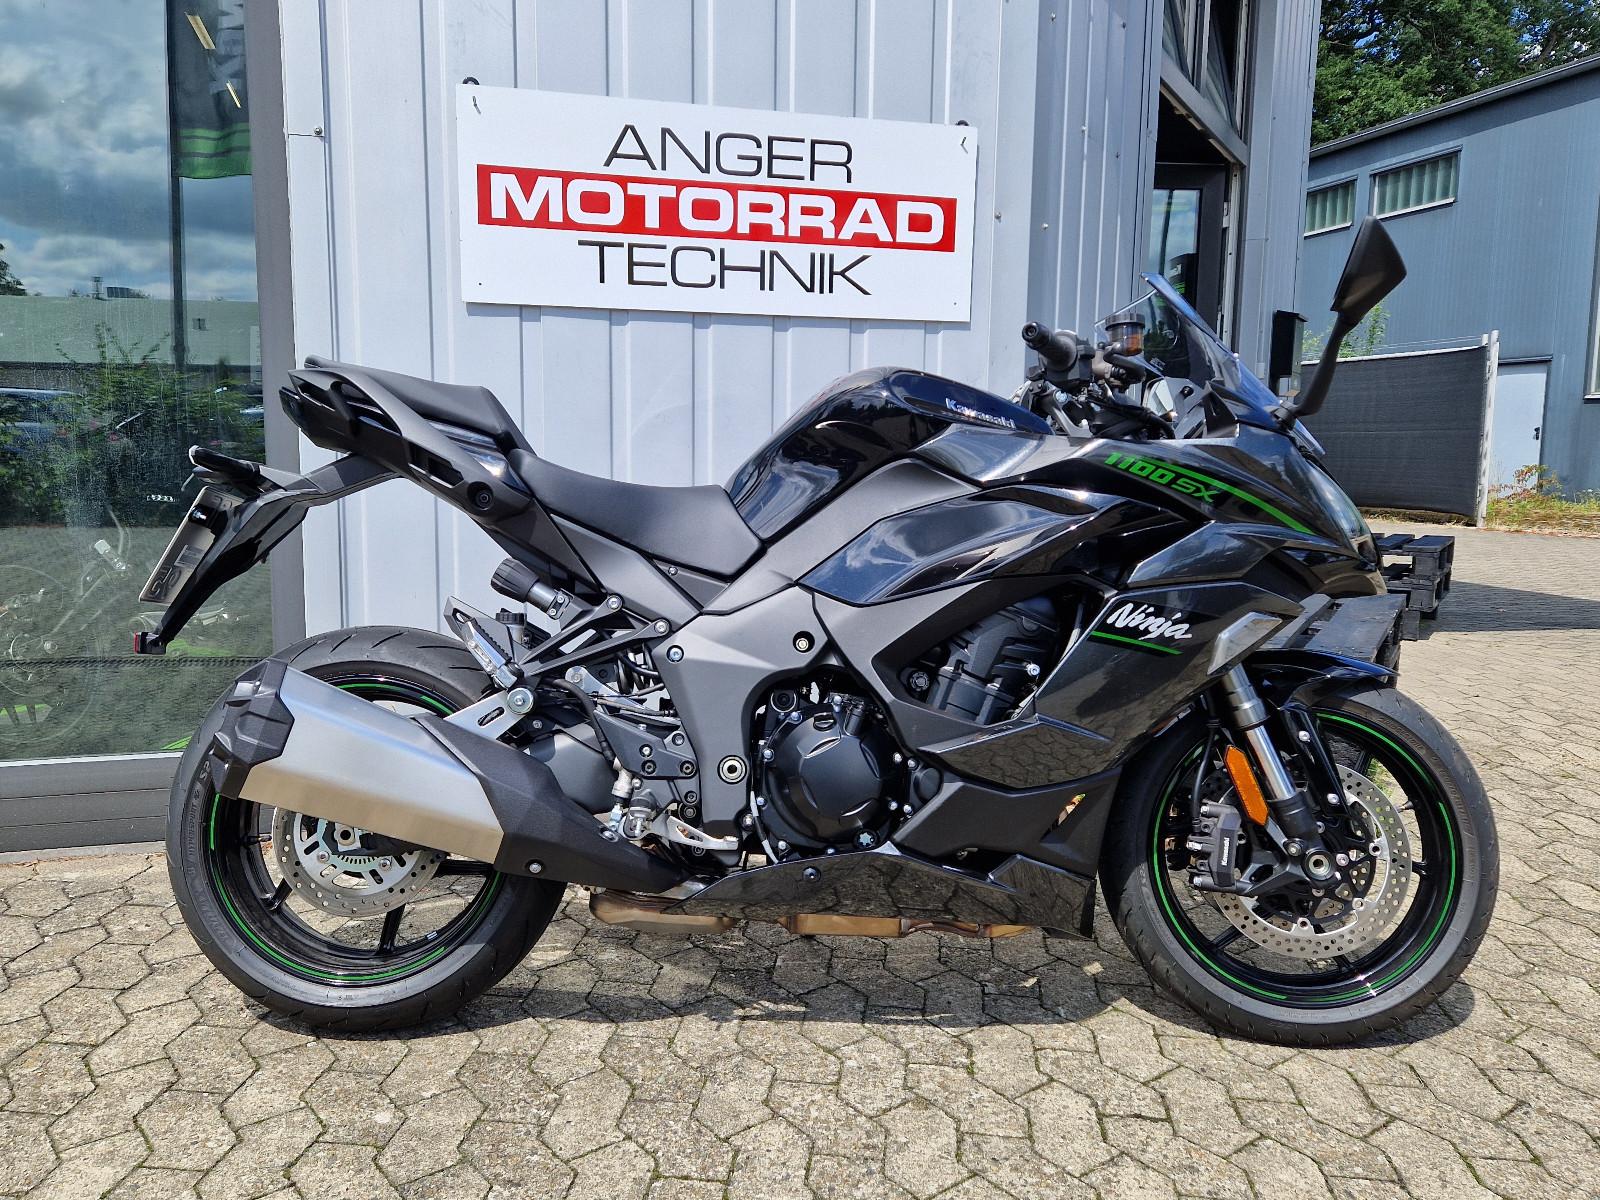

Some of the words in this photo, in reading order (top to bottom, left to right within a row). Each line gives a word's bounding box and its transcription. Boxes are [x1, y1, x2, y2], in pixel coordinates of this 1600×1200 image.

[603, 124, 853, 183] ANGER
[489, 172, 945, 245] MOTORRAD
[577, 239, 873, 296] TECHNIK
[945, 397, 1016, 431] Kawasaki
[1106, 602, 1193, 641] Ninja
